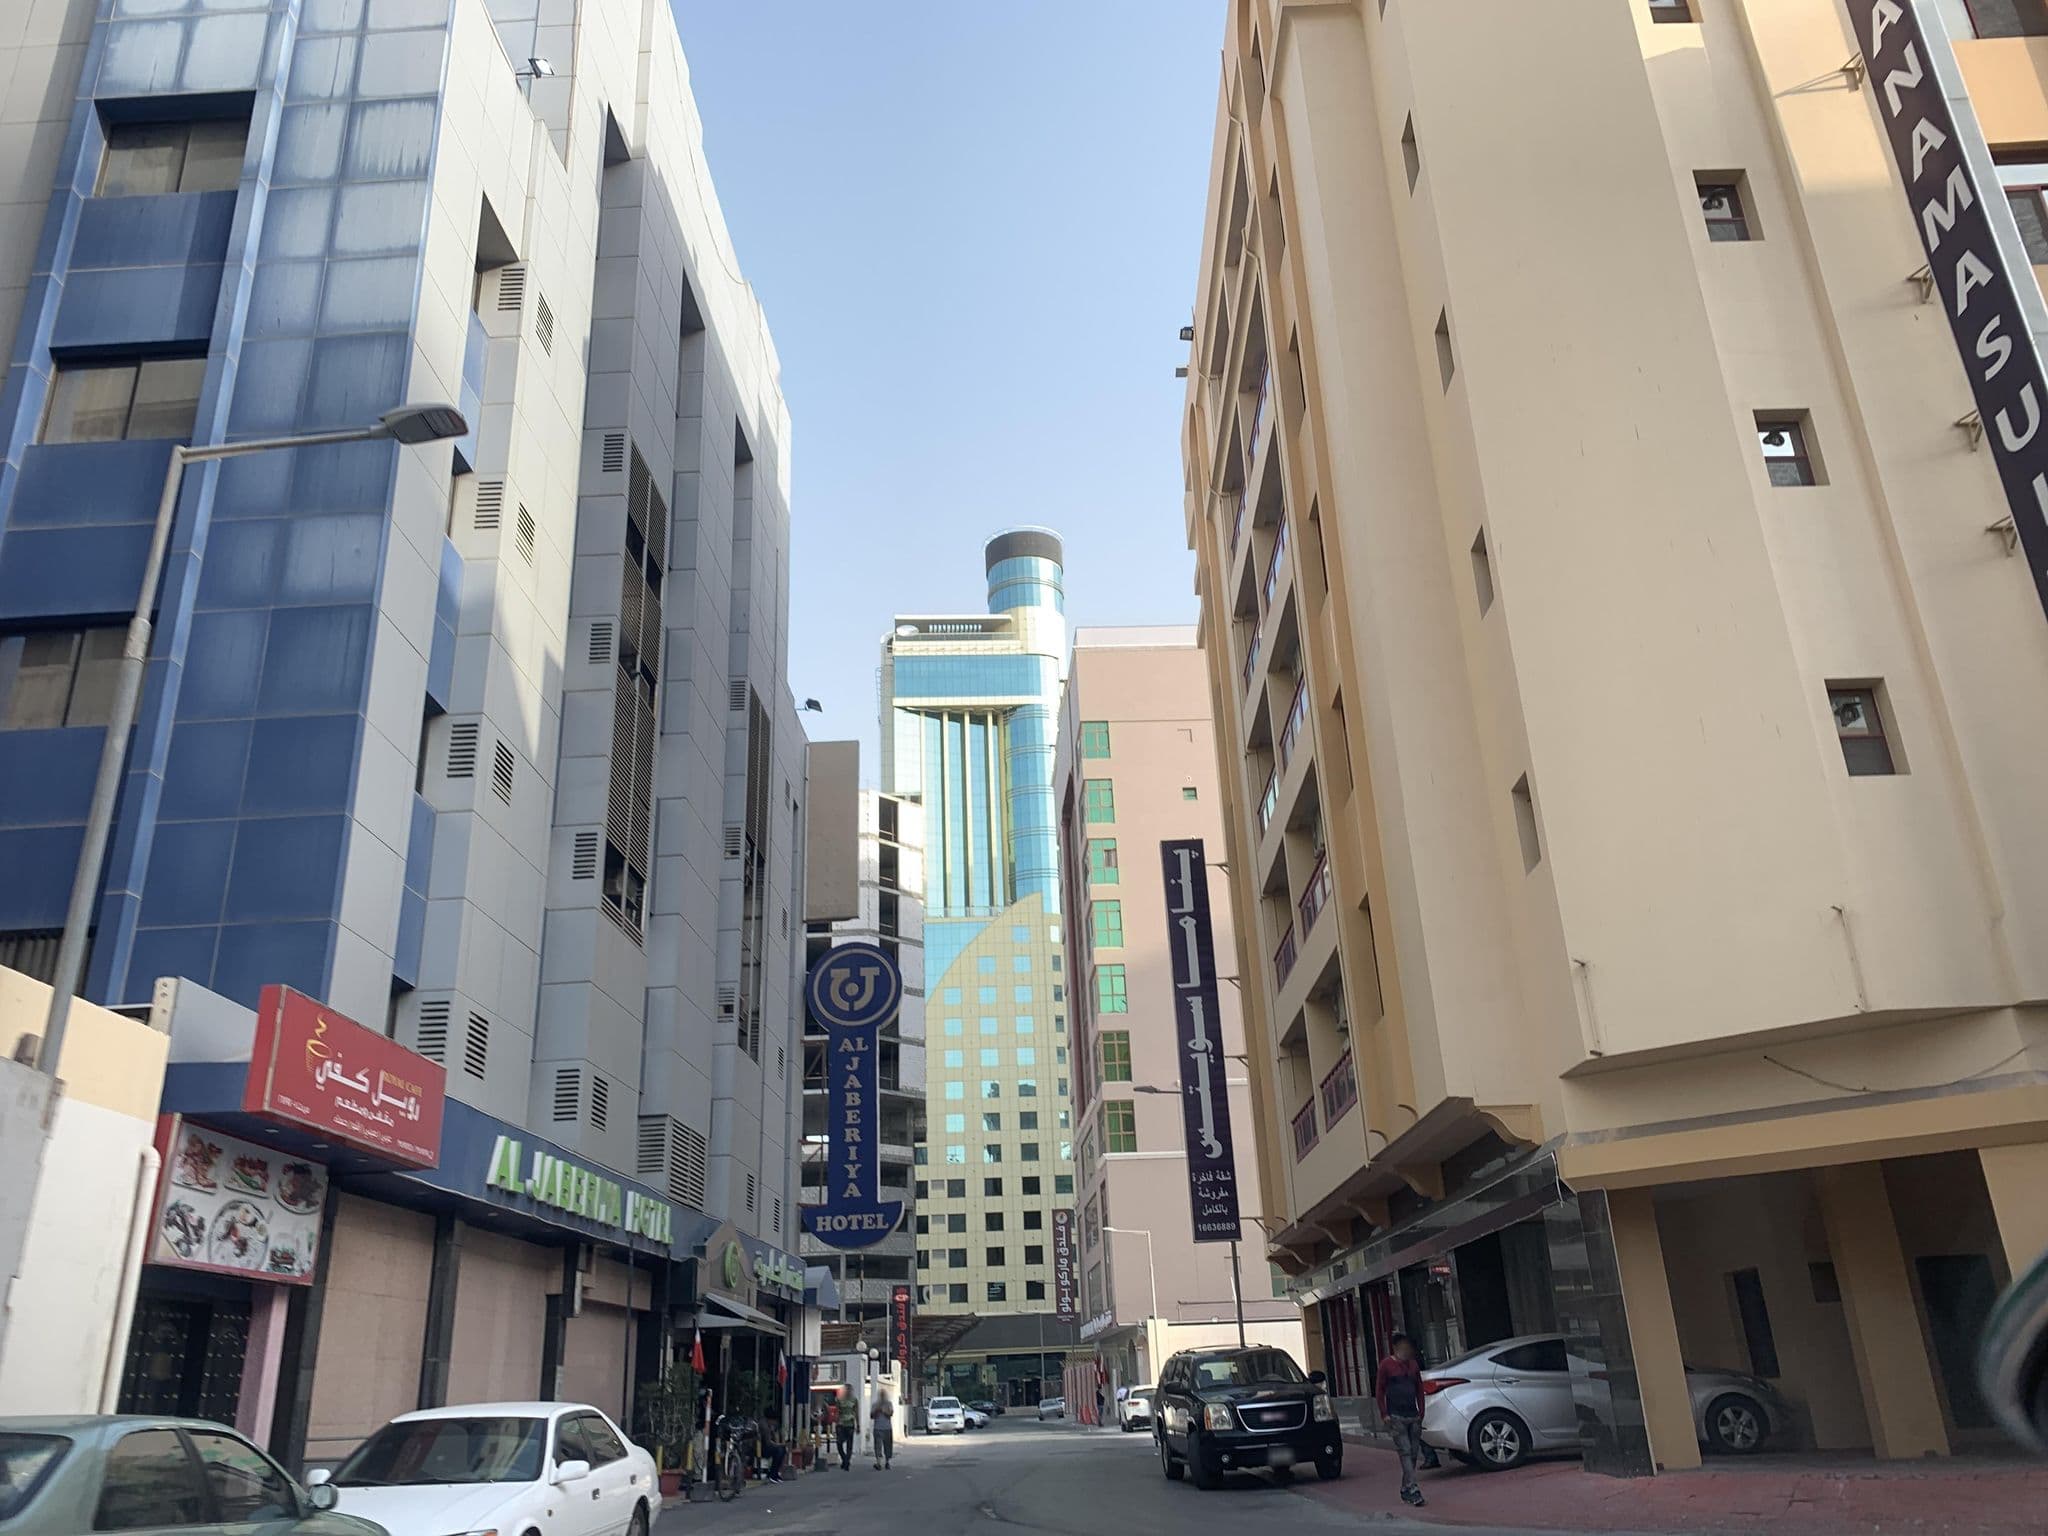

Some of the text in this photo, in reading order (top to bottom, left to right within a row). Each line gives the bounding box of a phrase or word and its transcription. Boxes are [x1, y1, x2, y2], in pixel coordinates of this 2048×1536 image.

[838, 1037, 869, 1052] AL
[843, 1057, 862, 1198] JABERIYA
[486, 1135, 526, 1194] AL
[816, 1214, 889, 1232] HOTEL
[1056, 1225, 1069, 1256] فندق
